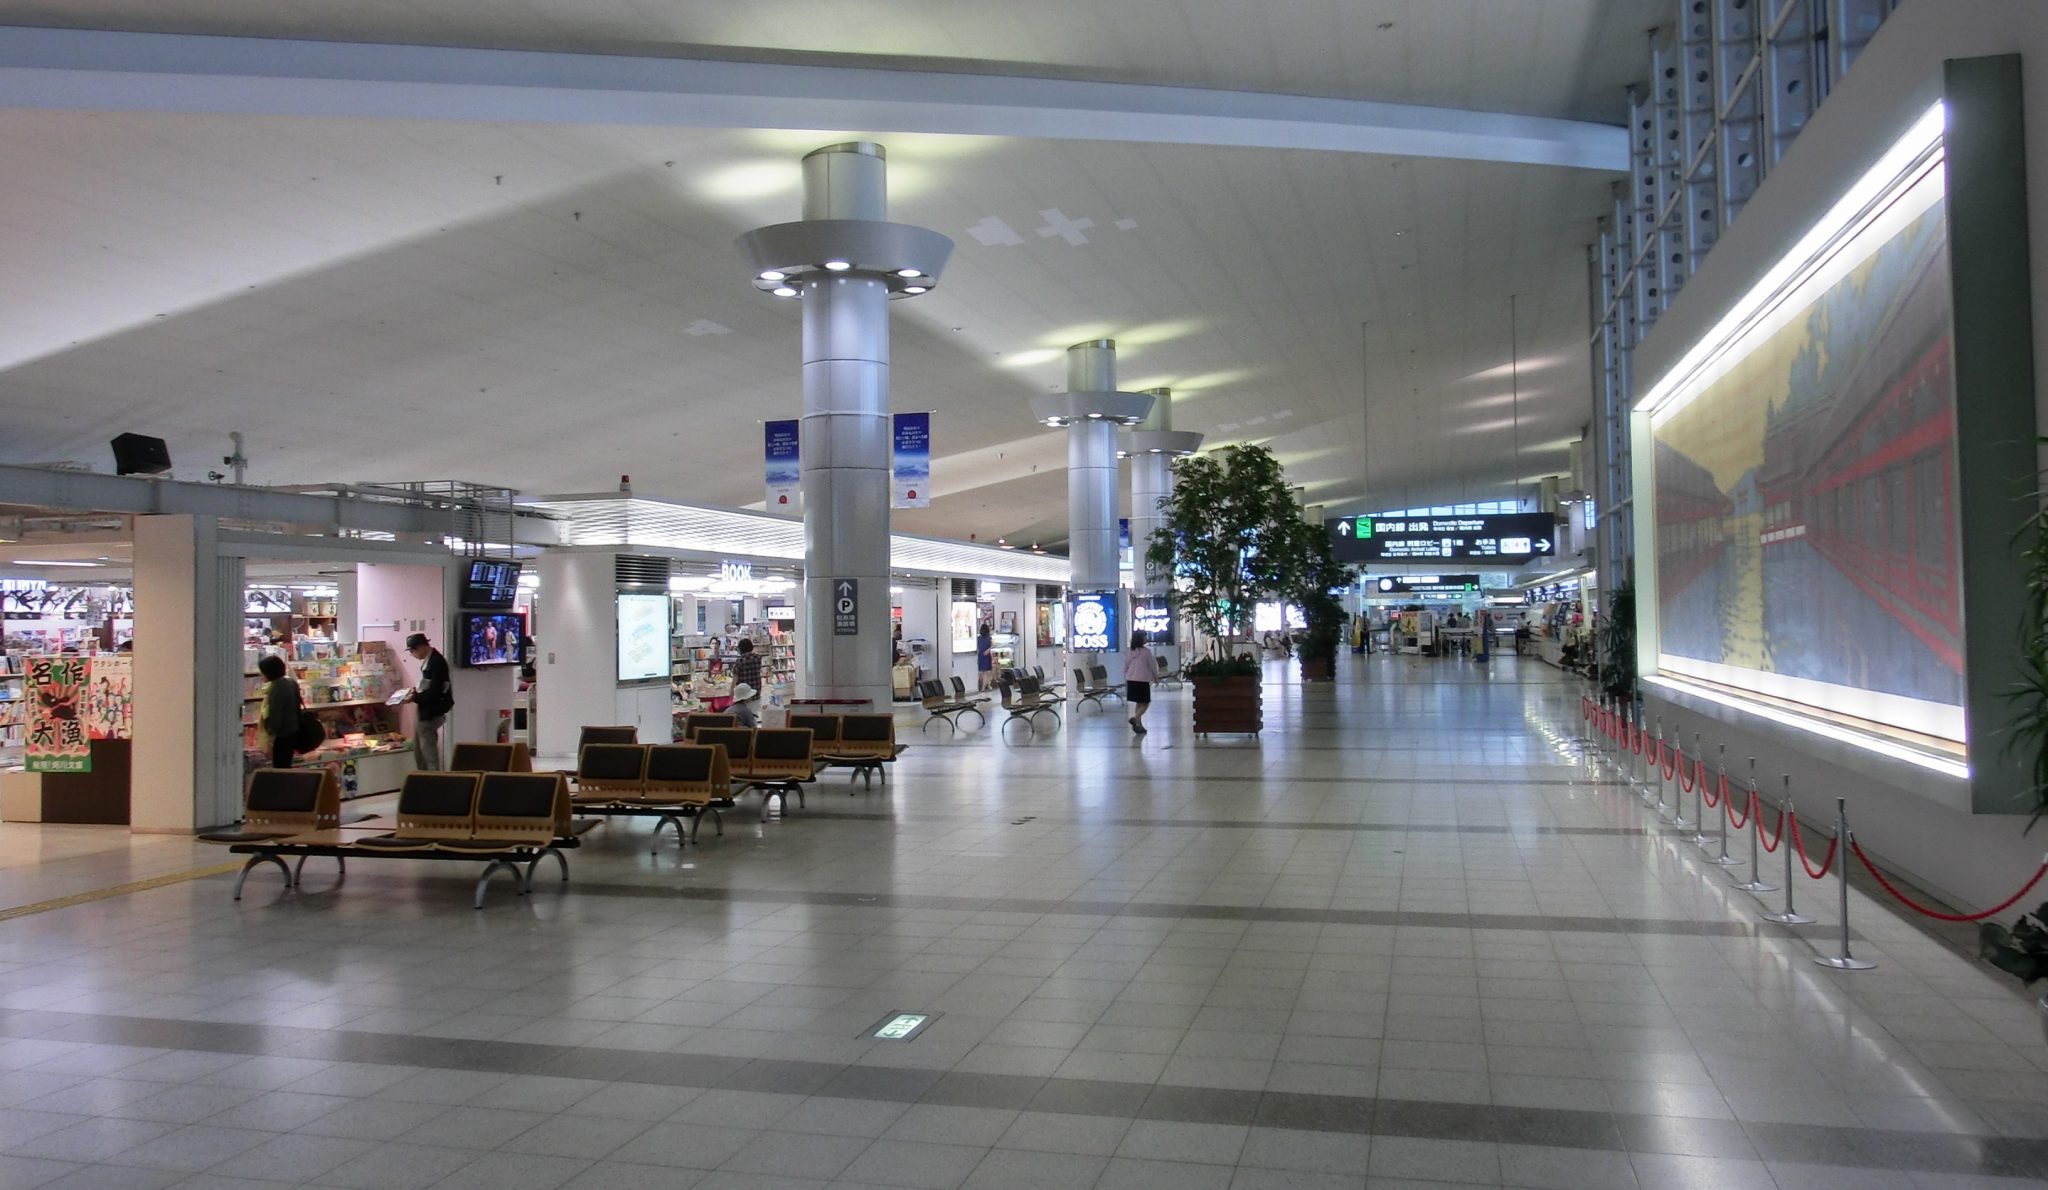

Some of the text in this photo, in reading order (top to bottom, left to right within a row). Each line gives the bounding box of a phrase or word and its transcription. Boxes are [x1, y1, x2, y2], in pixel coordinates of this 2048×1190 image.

[1375, 523, 1405, 532] 国内線
[1408, 522, 1429, 531] 出発
[721, 564, 752, 581] BOOK
[842, 600, 850, 611] P
[1134, 618, 1170, 632] NEX
[1074, 635, 1108, 647] BOSS
